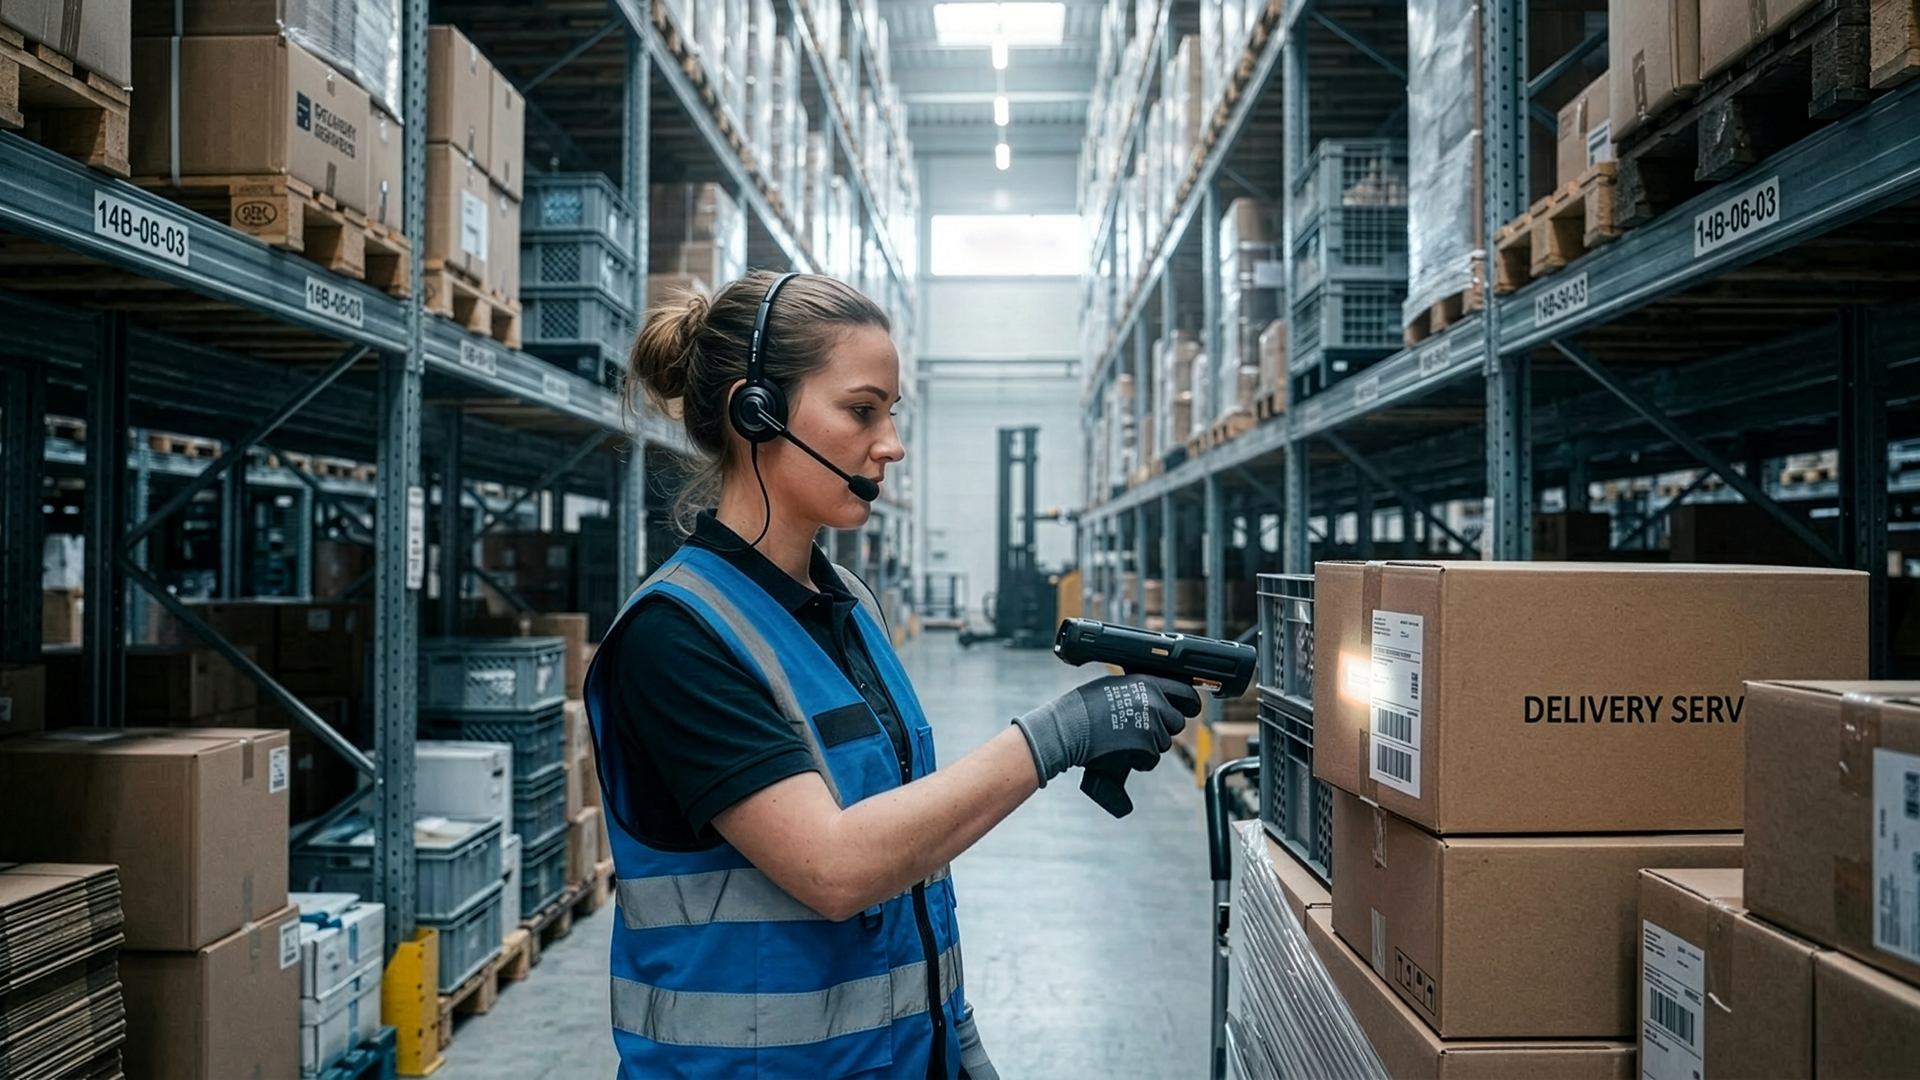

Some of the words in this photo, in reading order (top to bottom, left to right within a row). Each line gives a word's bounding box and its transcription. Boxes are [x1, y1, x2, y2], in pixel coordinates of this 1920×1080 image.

[1697, 186, 1776, 248] 14B-06-03
[1523, 695, 1664, 724] DELIVERY
[1670, 695, 1745, 724] SERV
